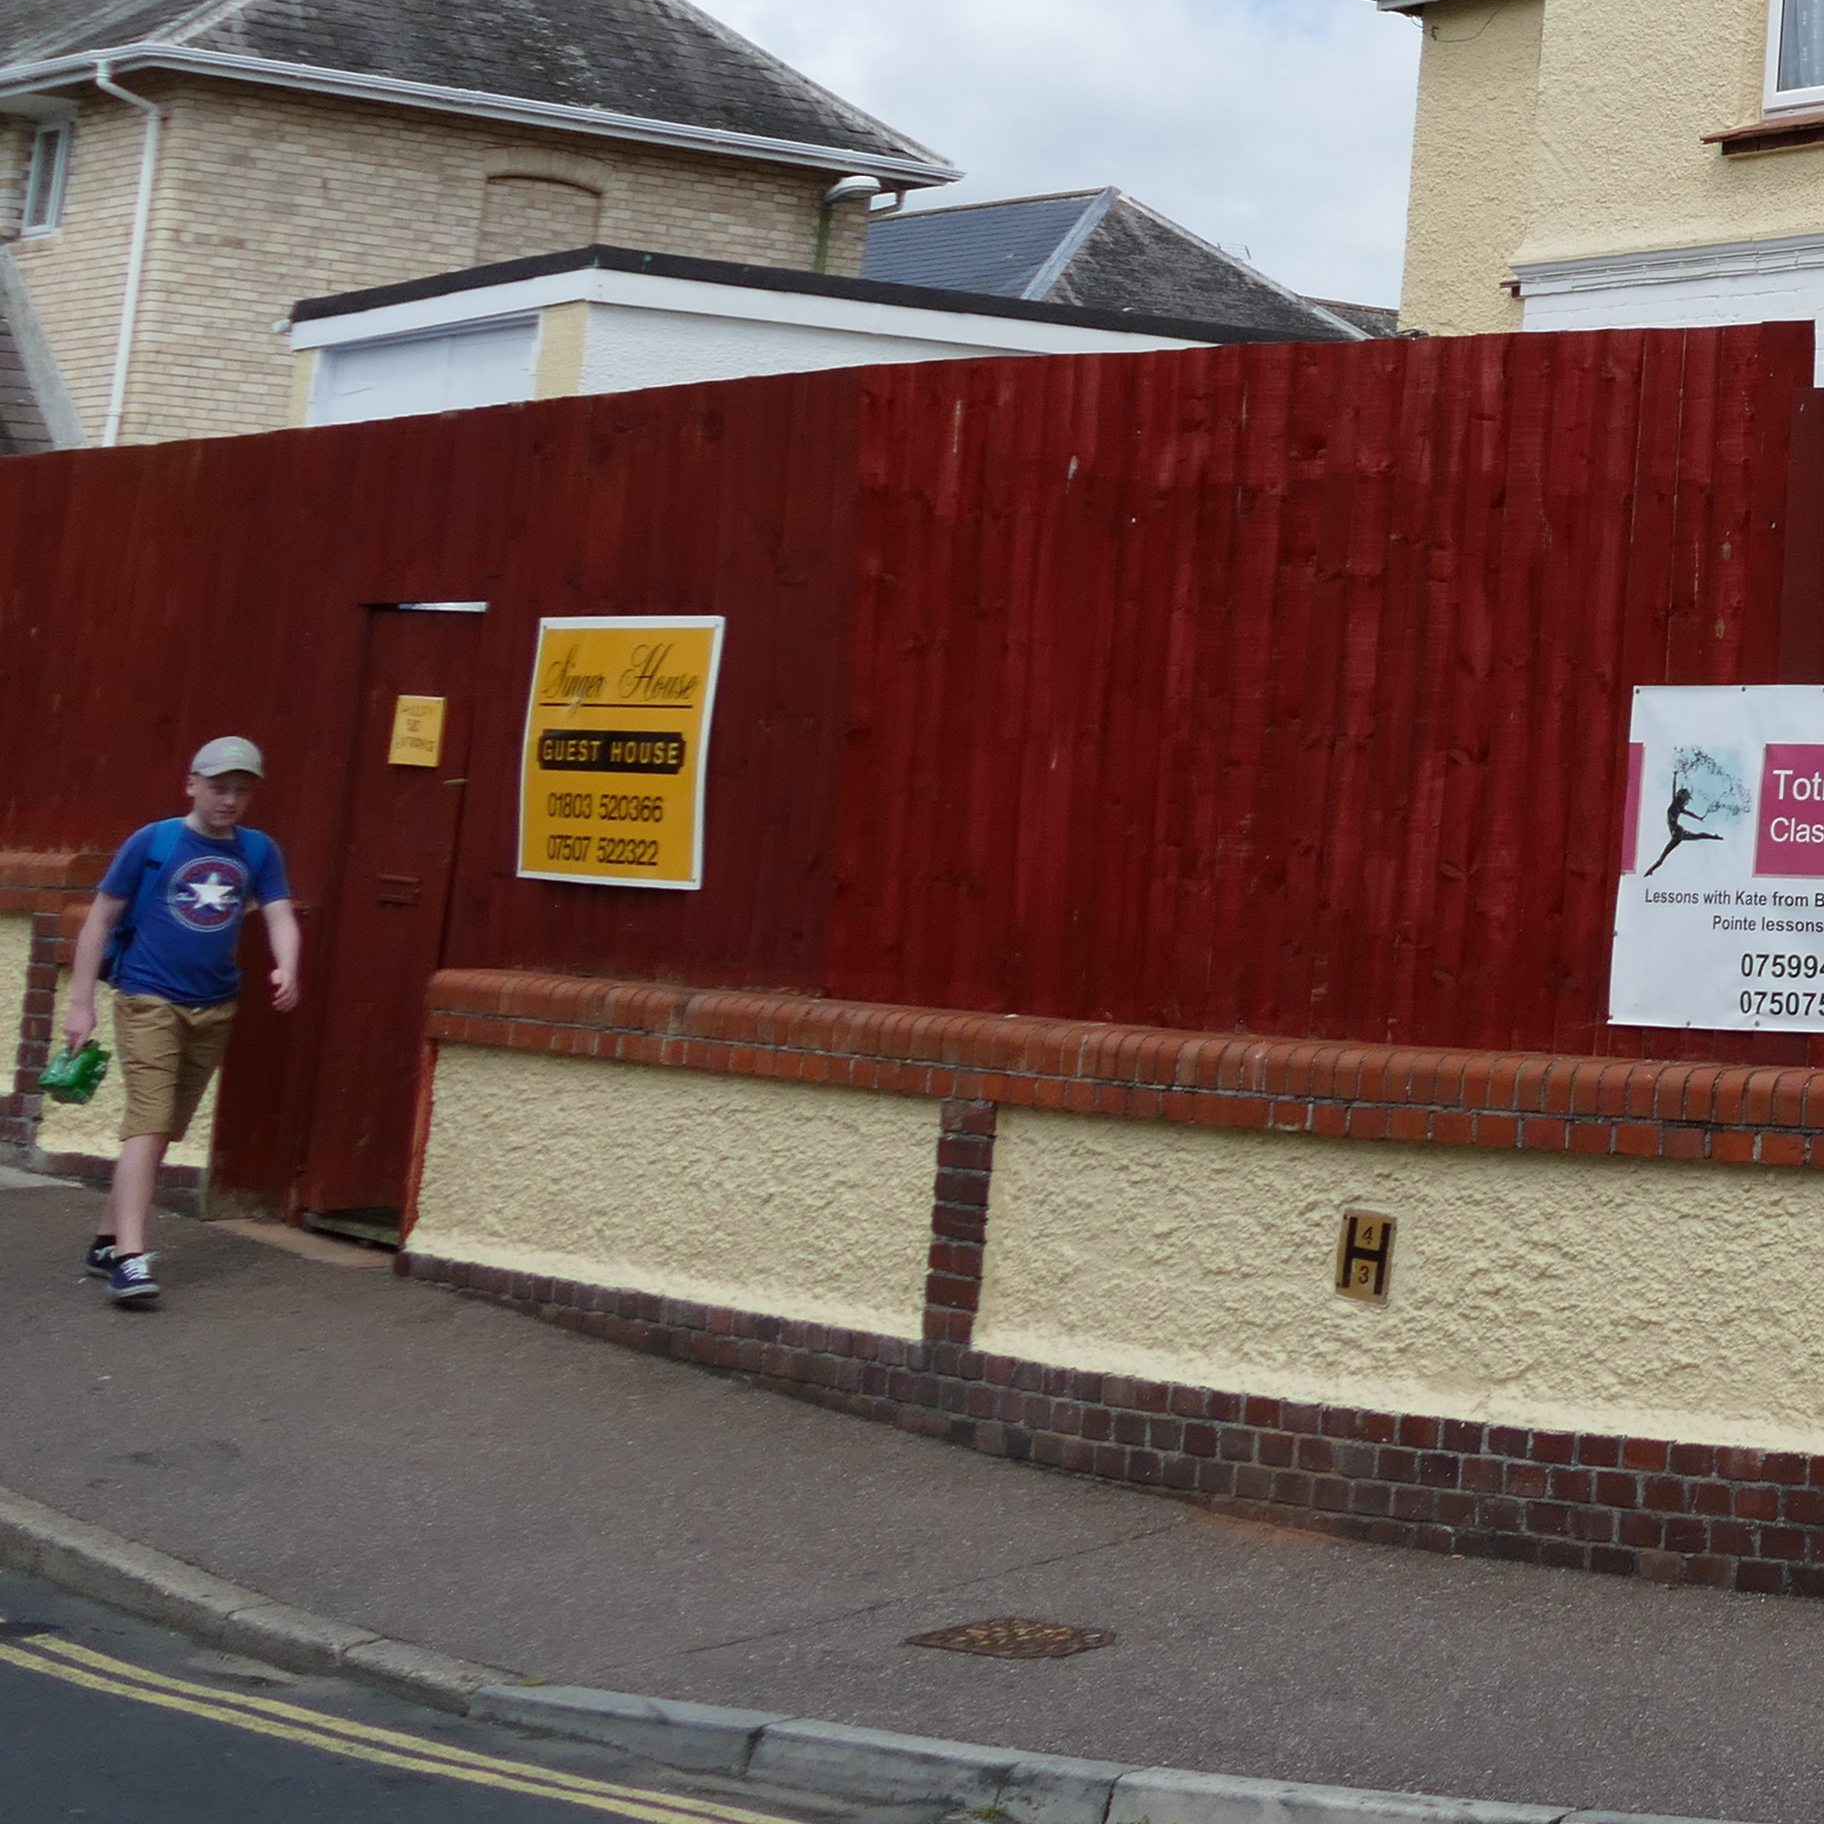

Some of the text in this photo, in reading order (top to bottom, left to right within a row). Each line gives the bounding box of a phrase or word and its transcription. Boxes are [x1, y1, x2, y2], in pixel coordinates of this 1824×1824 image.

[542, 642, 698, 718] Singer House
[543, 739, 680, 765] GUEST HOUSE
[547, 792, 664, 823] 01803 520366
[547, 835, 659, 866] 07507 522322
[1644, 887, 1699, 905] Lessons
[1703, 888, 1732, 907] with
[1735, 890, 1768, 908] Kate
[1772, 891, 1809, 909] from
[1712, 915, 1757, 932] Pointe
[1761, 917, 1824, 934] lessons
[1362, 1226, 1373, 1244] 4
[1342, 1217, 1392, 1295] H
[1359, 1265, 1369, 1284] 3
